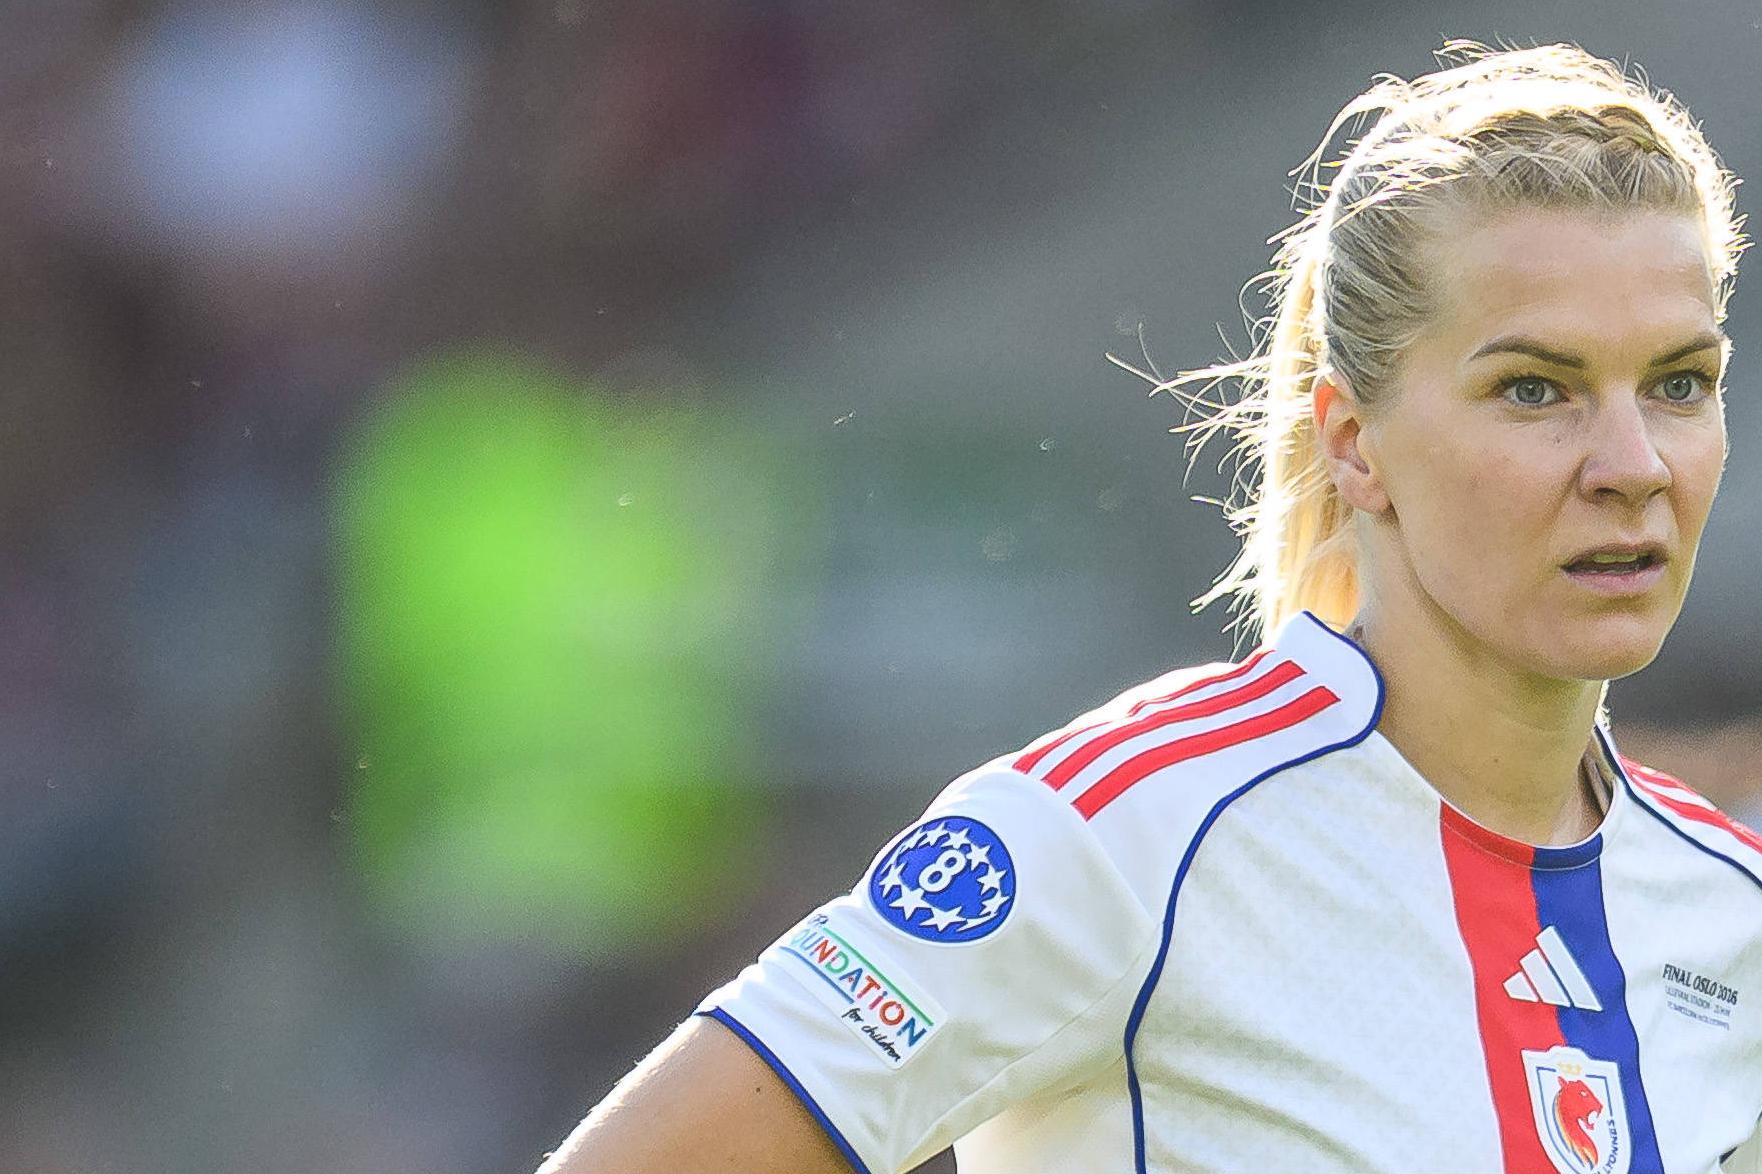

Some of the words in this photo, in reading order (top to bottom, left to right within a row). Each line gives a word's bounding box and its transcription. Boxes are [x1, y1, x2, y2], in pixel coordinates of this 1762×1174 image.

[918, 849, 969, 893] 8
[791, 928, 927, 1047] OUNDATION
[1662, 964, 1692, 987] FINAL
[1693, 975, 1718, 996] OSLO
[842, 1007, 863, 1024] for
[861, 1024, 901, 1062] children
